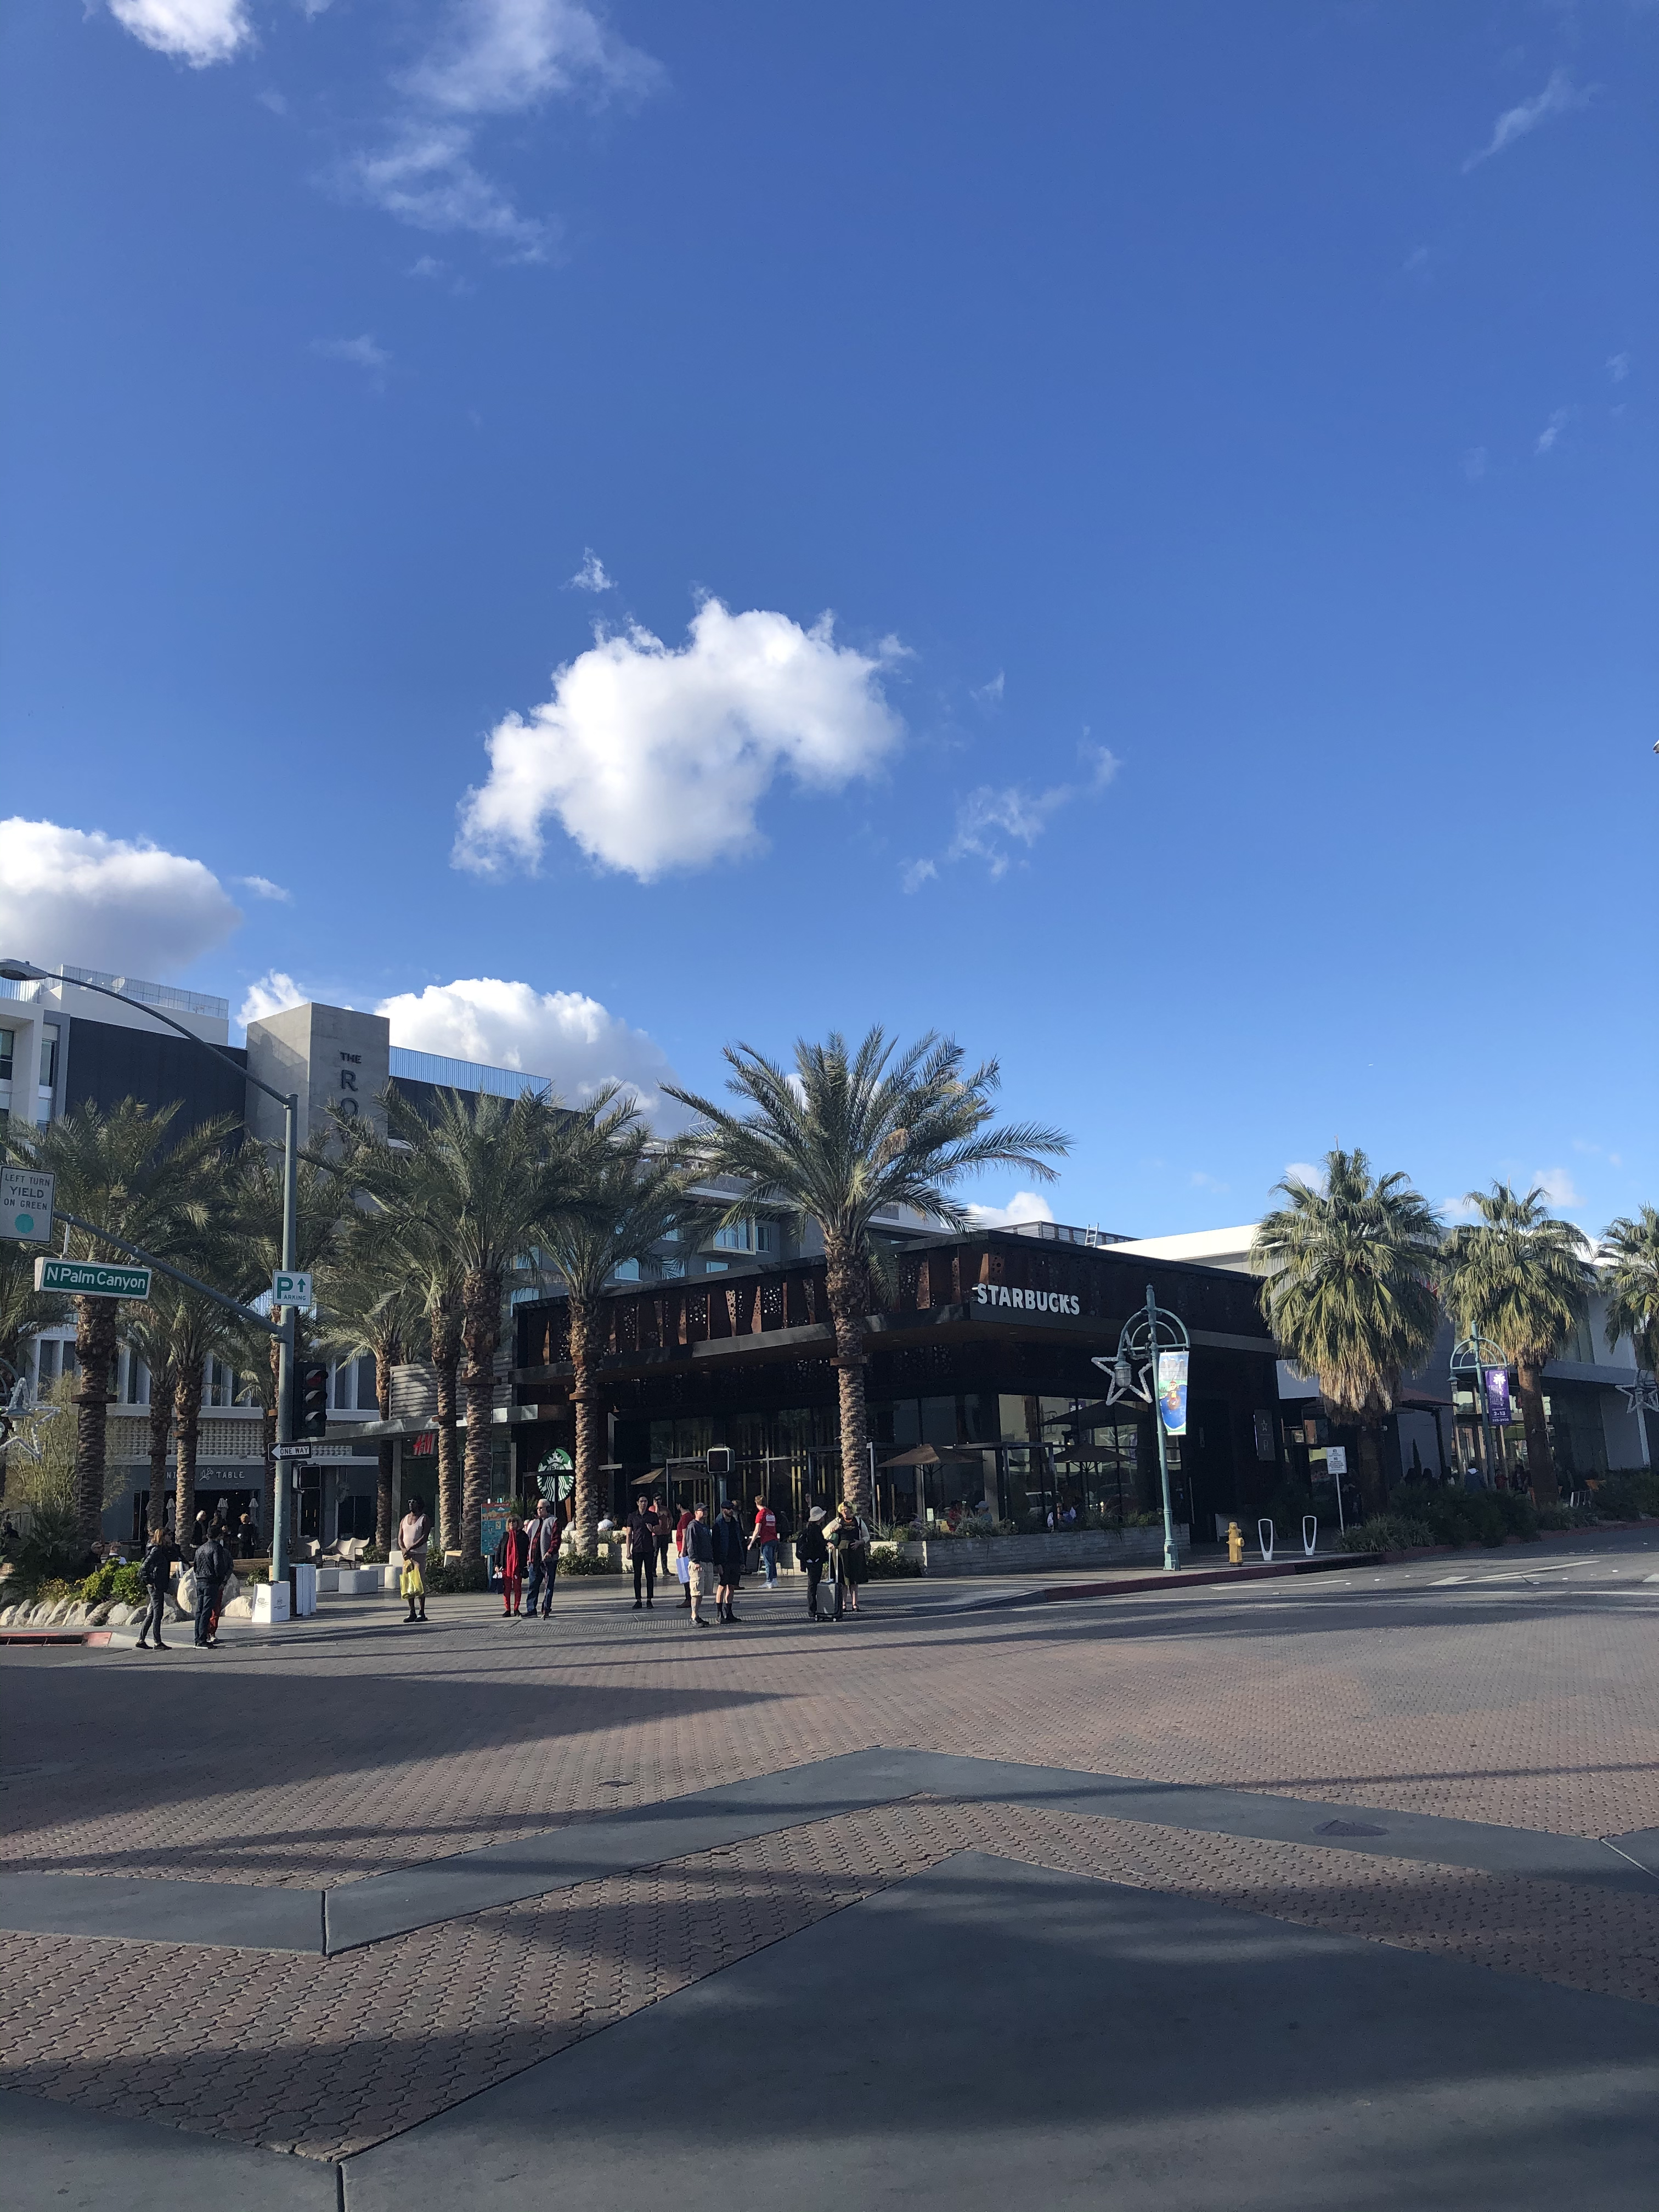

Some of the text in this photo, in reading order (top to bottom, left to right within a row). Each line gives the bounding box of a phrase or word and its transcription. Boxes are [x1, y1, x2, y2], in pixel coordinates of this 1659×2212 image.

[340, 1052, 362, 1064] THE
[5, 1174, 50, 1187] LEFT TURN
[10, 1186, 44, 1198] YIELD
[4, 1198, 47, 1210] ON GREEN
[47, 1266, 146, 1290] N Palm Canyon
[977, 1283, 1080, 1315] STARBUCKS
[413, 1433, 435, 1455] H&M
